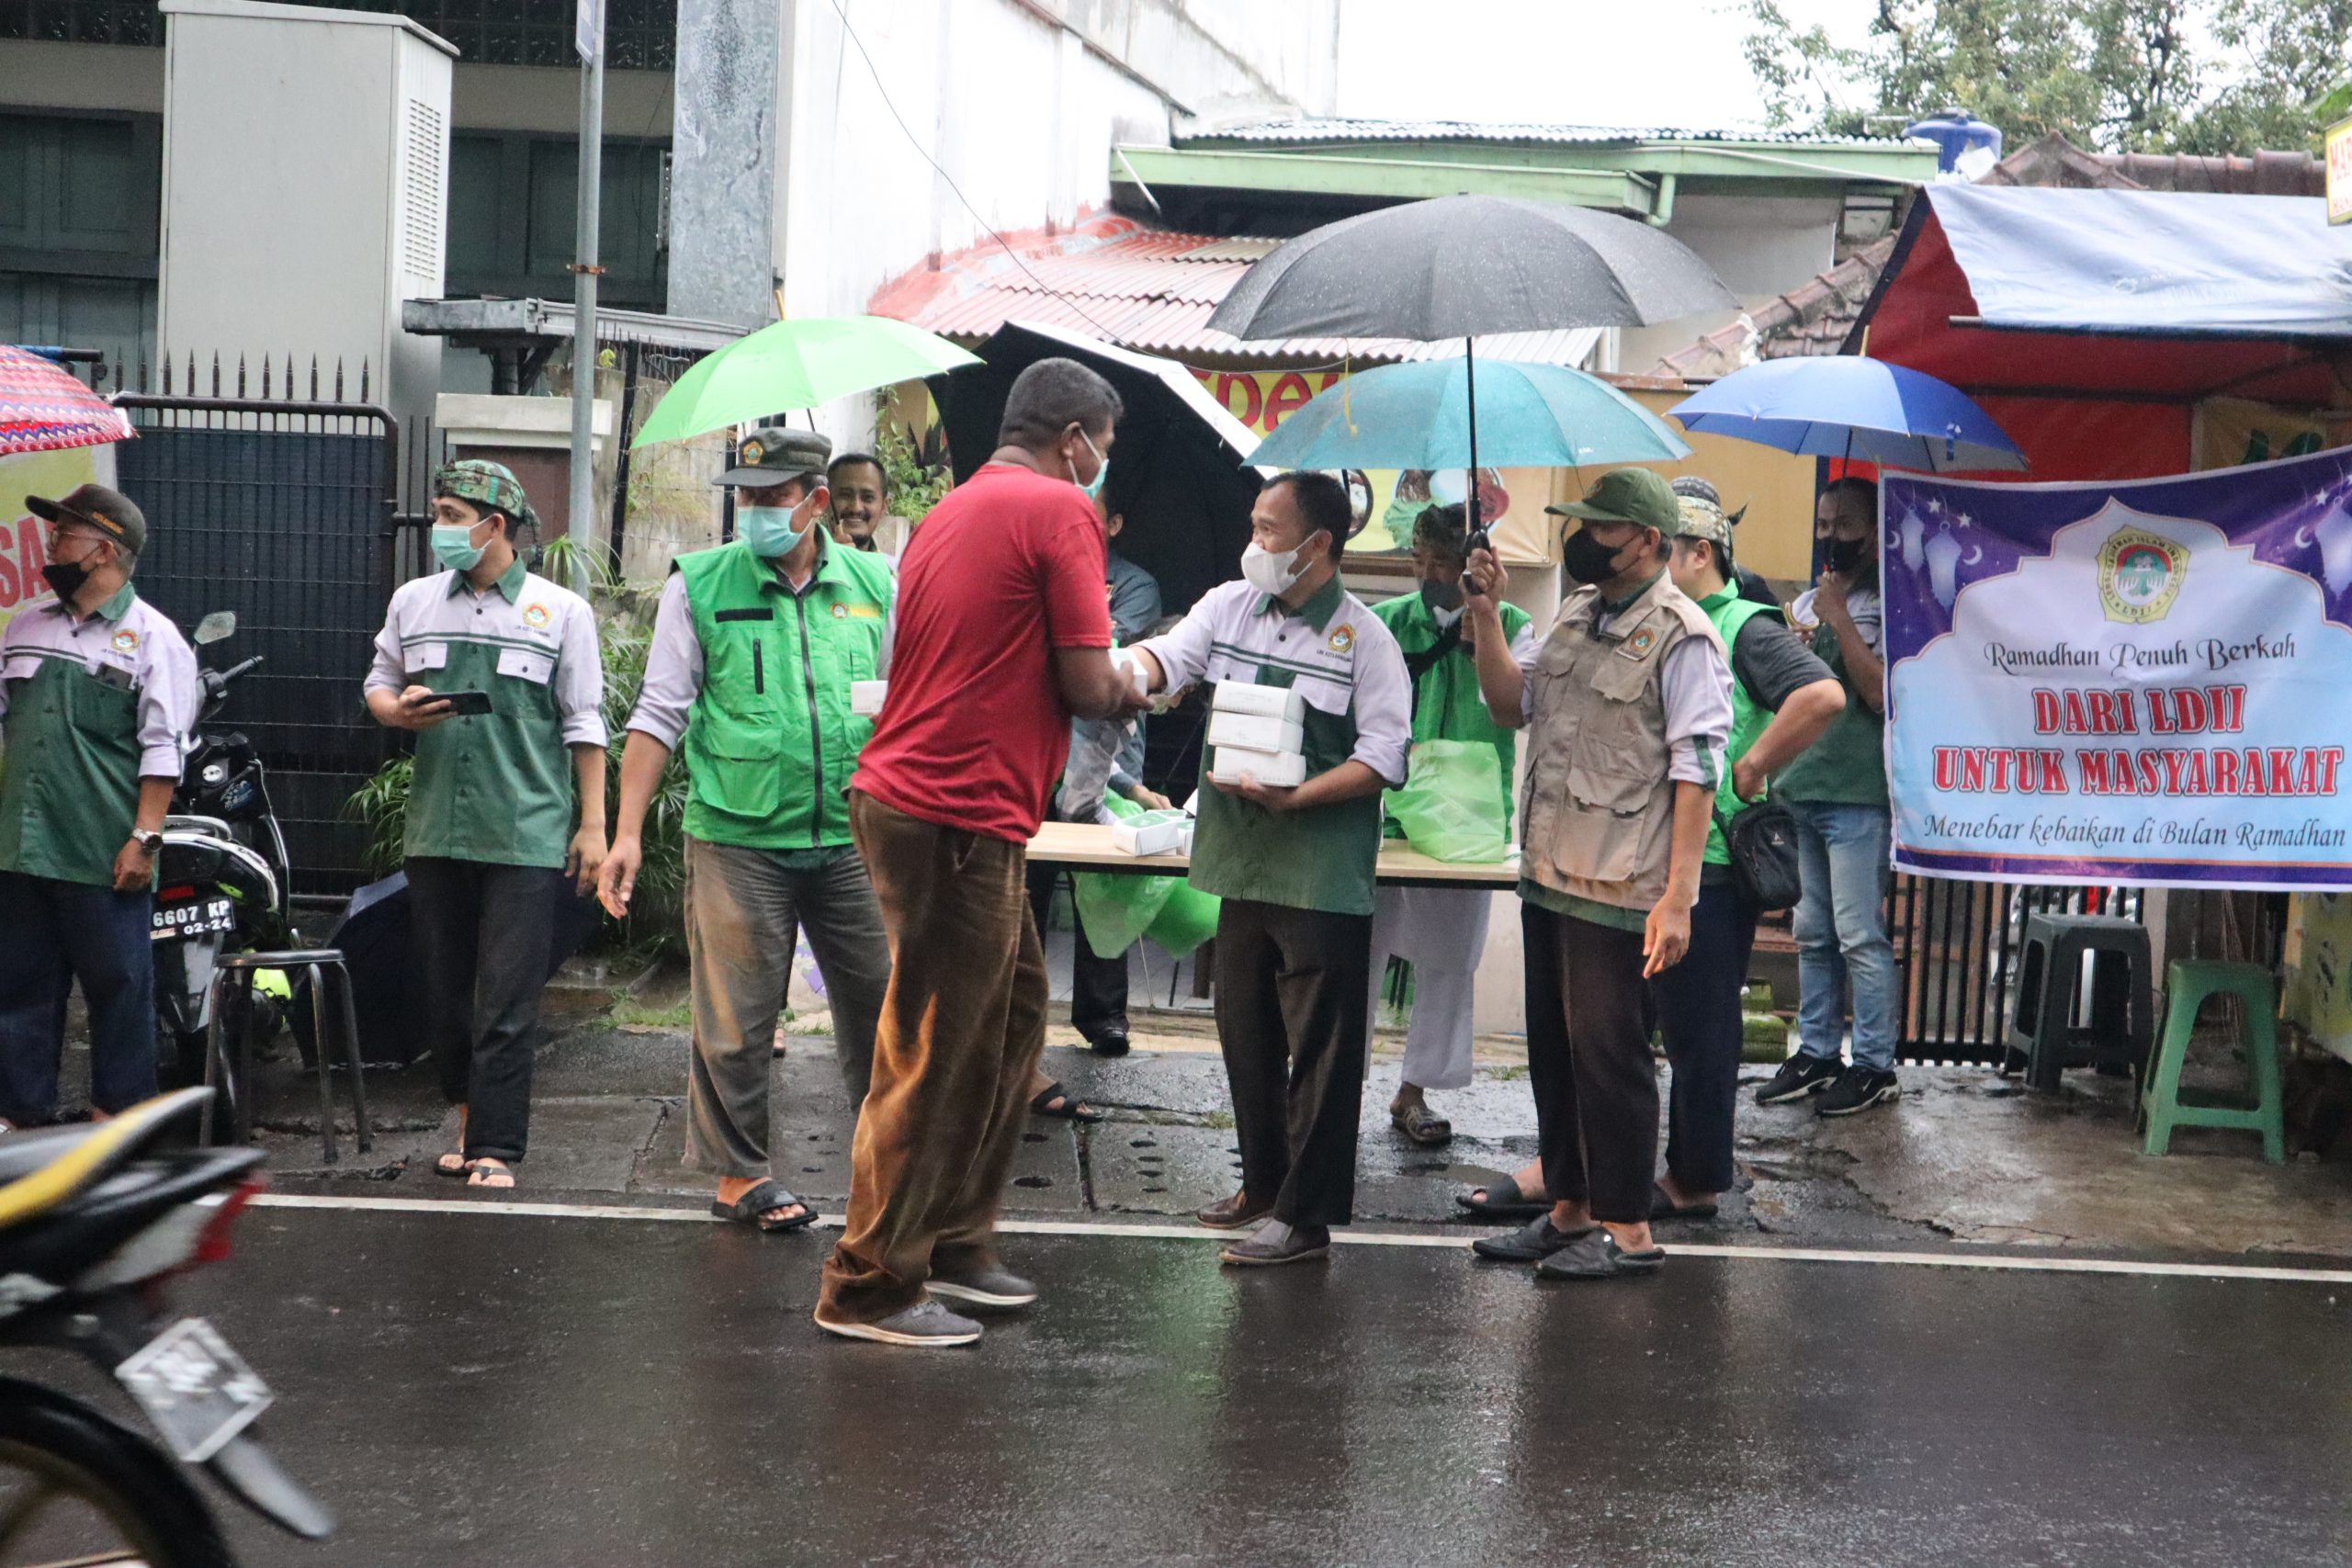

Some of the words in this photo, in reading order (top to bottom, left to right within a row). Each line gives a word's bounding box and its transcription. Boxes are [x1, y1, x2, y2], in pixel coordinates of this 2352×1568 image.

[2136, 536, 2165, 547] ISLAM
[0, 516, 57, 608] SA
[1984, 642, 2099, 676] Ramadhan
[2109, 639, 2188, 677] Penuh
[2196, 633, 2295, 671] Berkah
[2031, 688, 2139, 735] DARI
[2144, 684, 2247, 735] LDII
[1933, 745, 2069, 795] UNTUK
[2076, 746, 2344, 796] MASYARAKAT
[1924, 814, 2024, 840] Menebar
[2030, 814, 2125, 849] kebaikan
[2132, 817, 2156, 844] di
[2160, 818, 2227, 845] Bulan
[2235, 818, 2346, 851] Ramadhan
[153, 906, 198, 927] 6607
[208, 900, 230, 918] KP
[184, 917, 232, 935] 02-24
